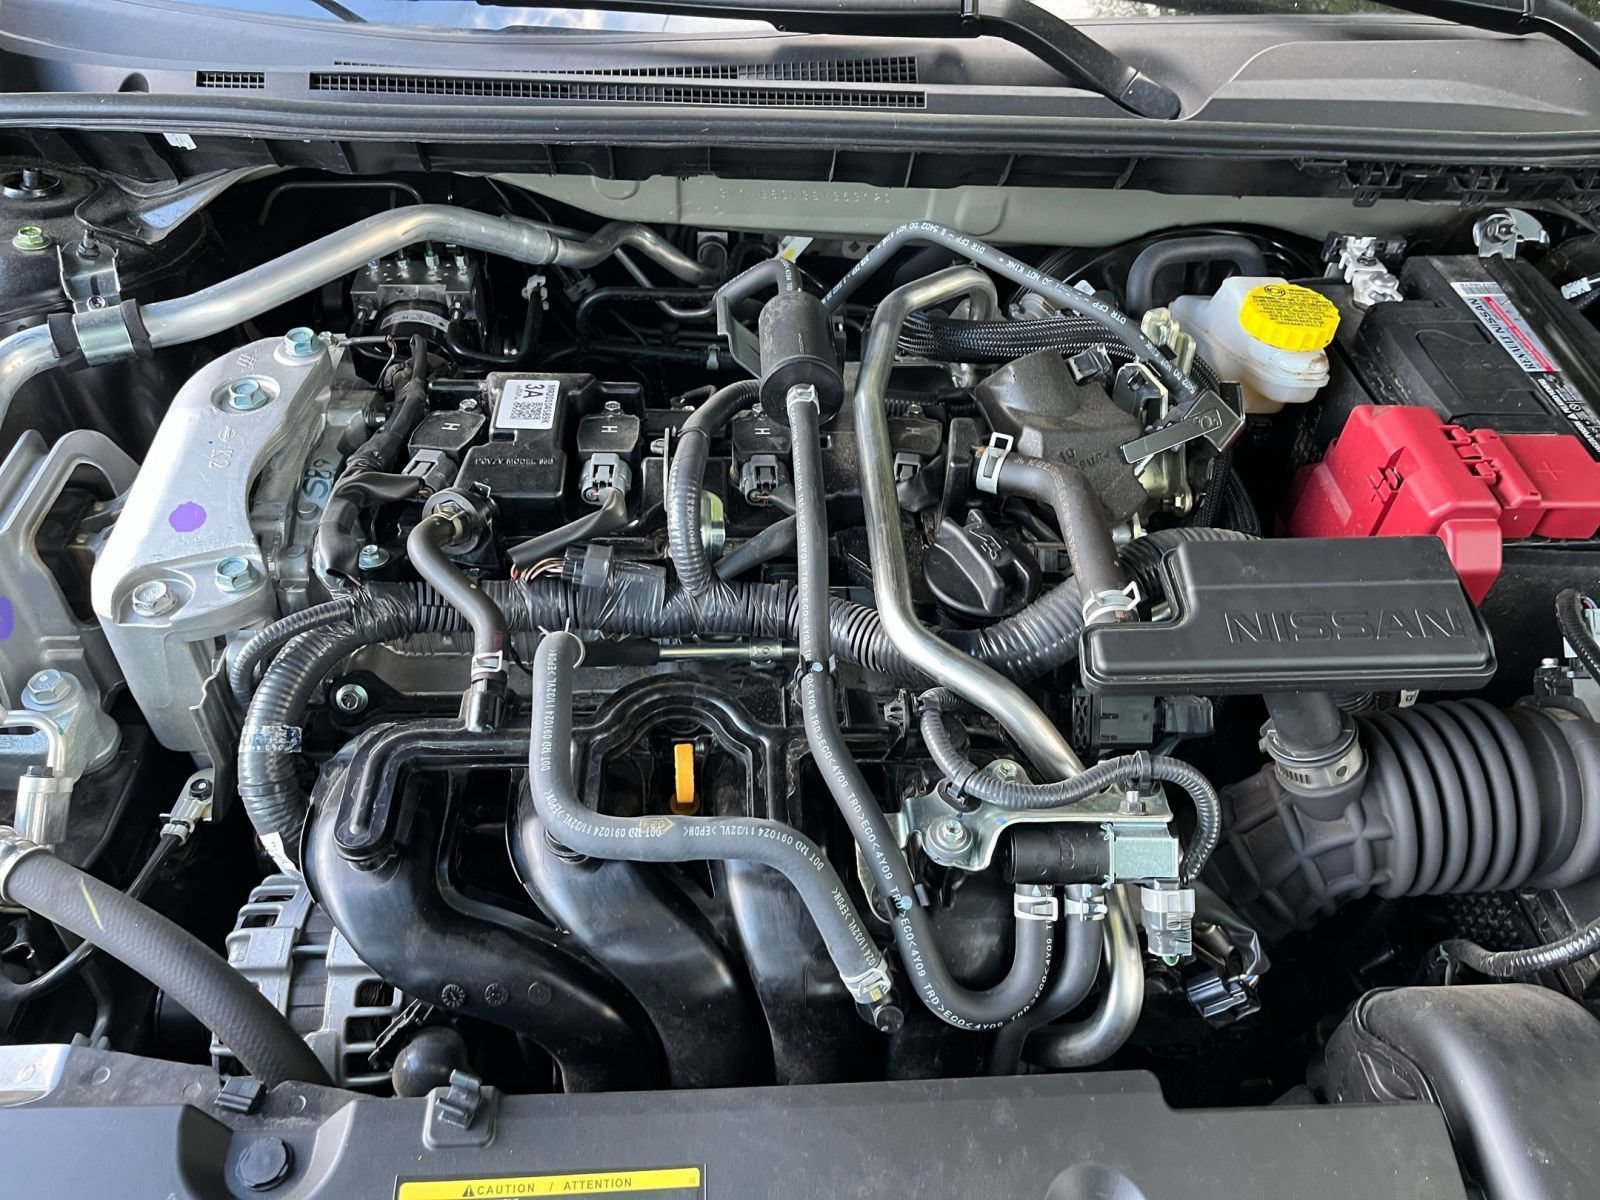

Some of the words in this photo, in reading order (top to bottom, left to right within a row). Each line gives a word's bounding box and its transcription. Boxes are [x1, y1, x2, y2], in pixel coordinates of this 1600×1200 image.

[955, 236, 970, 247] CFP
[971, 242, 986, 255] DTR
[1025, 272, 1041, 283] NOT
[1091, 301, 1109, 313] CFP
[1110, 310, 1127, 325] DTR
[1468, 298, 1506, 335] NISSAN
[523, 383, 545, 399] 3A
[208, 449, 234, 469] K2
[1224, 607, 1468, 643] NISSAN
[543, 710, 555, 739] 091024
[541, 756, 551, 772] DOT
[592, 826, 627, 838] 091024
[757, 826, 794, 845] 091024
[809, 854, 825, 871] DOT
[810, 713, 849, 789] TRD>ECO<4Y09
[847, 791, 893, 881] TRD>ECO<4Y09
[923, 982, 1004, 1031] TRD>ECO<4Y09
[477, 1183, 535, 1196] CAUTION
[563, 1178, 632, 1192] ATTENTION
